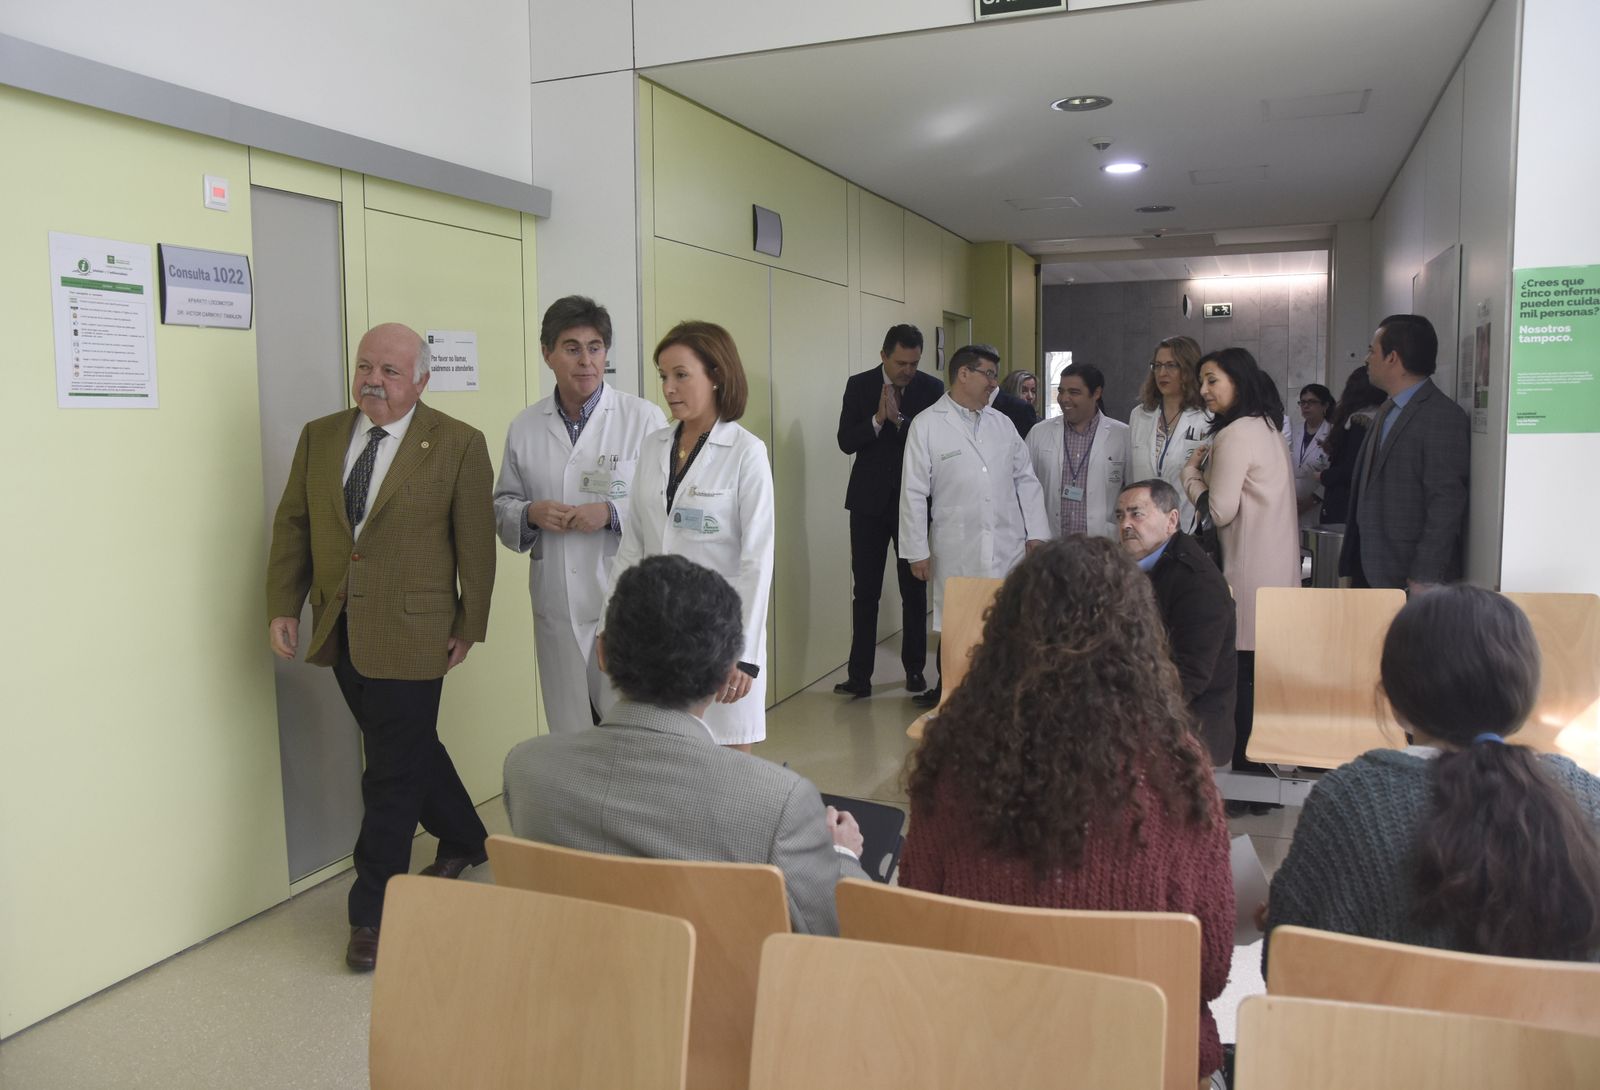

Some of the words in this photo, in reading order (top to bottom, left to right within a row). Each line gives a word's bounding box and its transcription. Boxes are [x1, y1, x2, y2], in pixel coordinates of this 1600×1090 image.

[168, 264, 211, 281] Consulta
[213, 266, 244, 285] 1022
[1521, 279, 1559, 290] ¿Crees
[1561, 278, 1585, 288] que
[1520, 289, 1551, 298] cinco
[1520, 298, 1564, 310] pueden
[1520, 309, 1538, 318] mil
[1540, 307, 1600, 320] personas?
[1519, 324, 1571, 334] Nosotros
[1519, 334, 1573, 344] tampoco.
